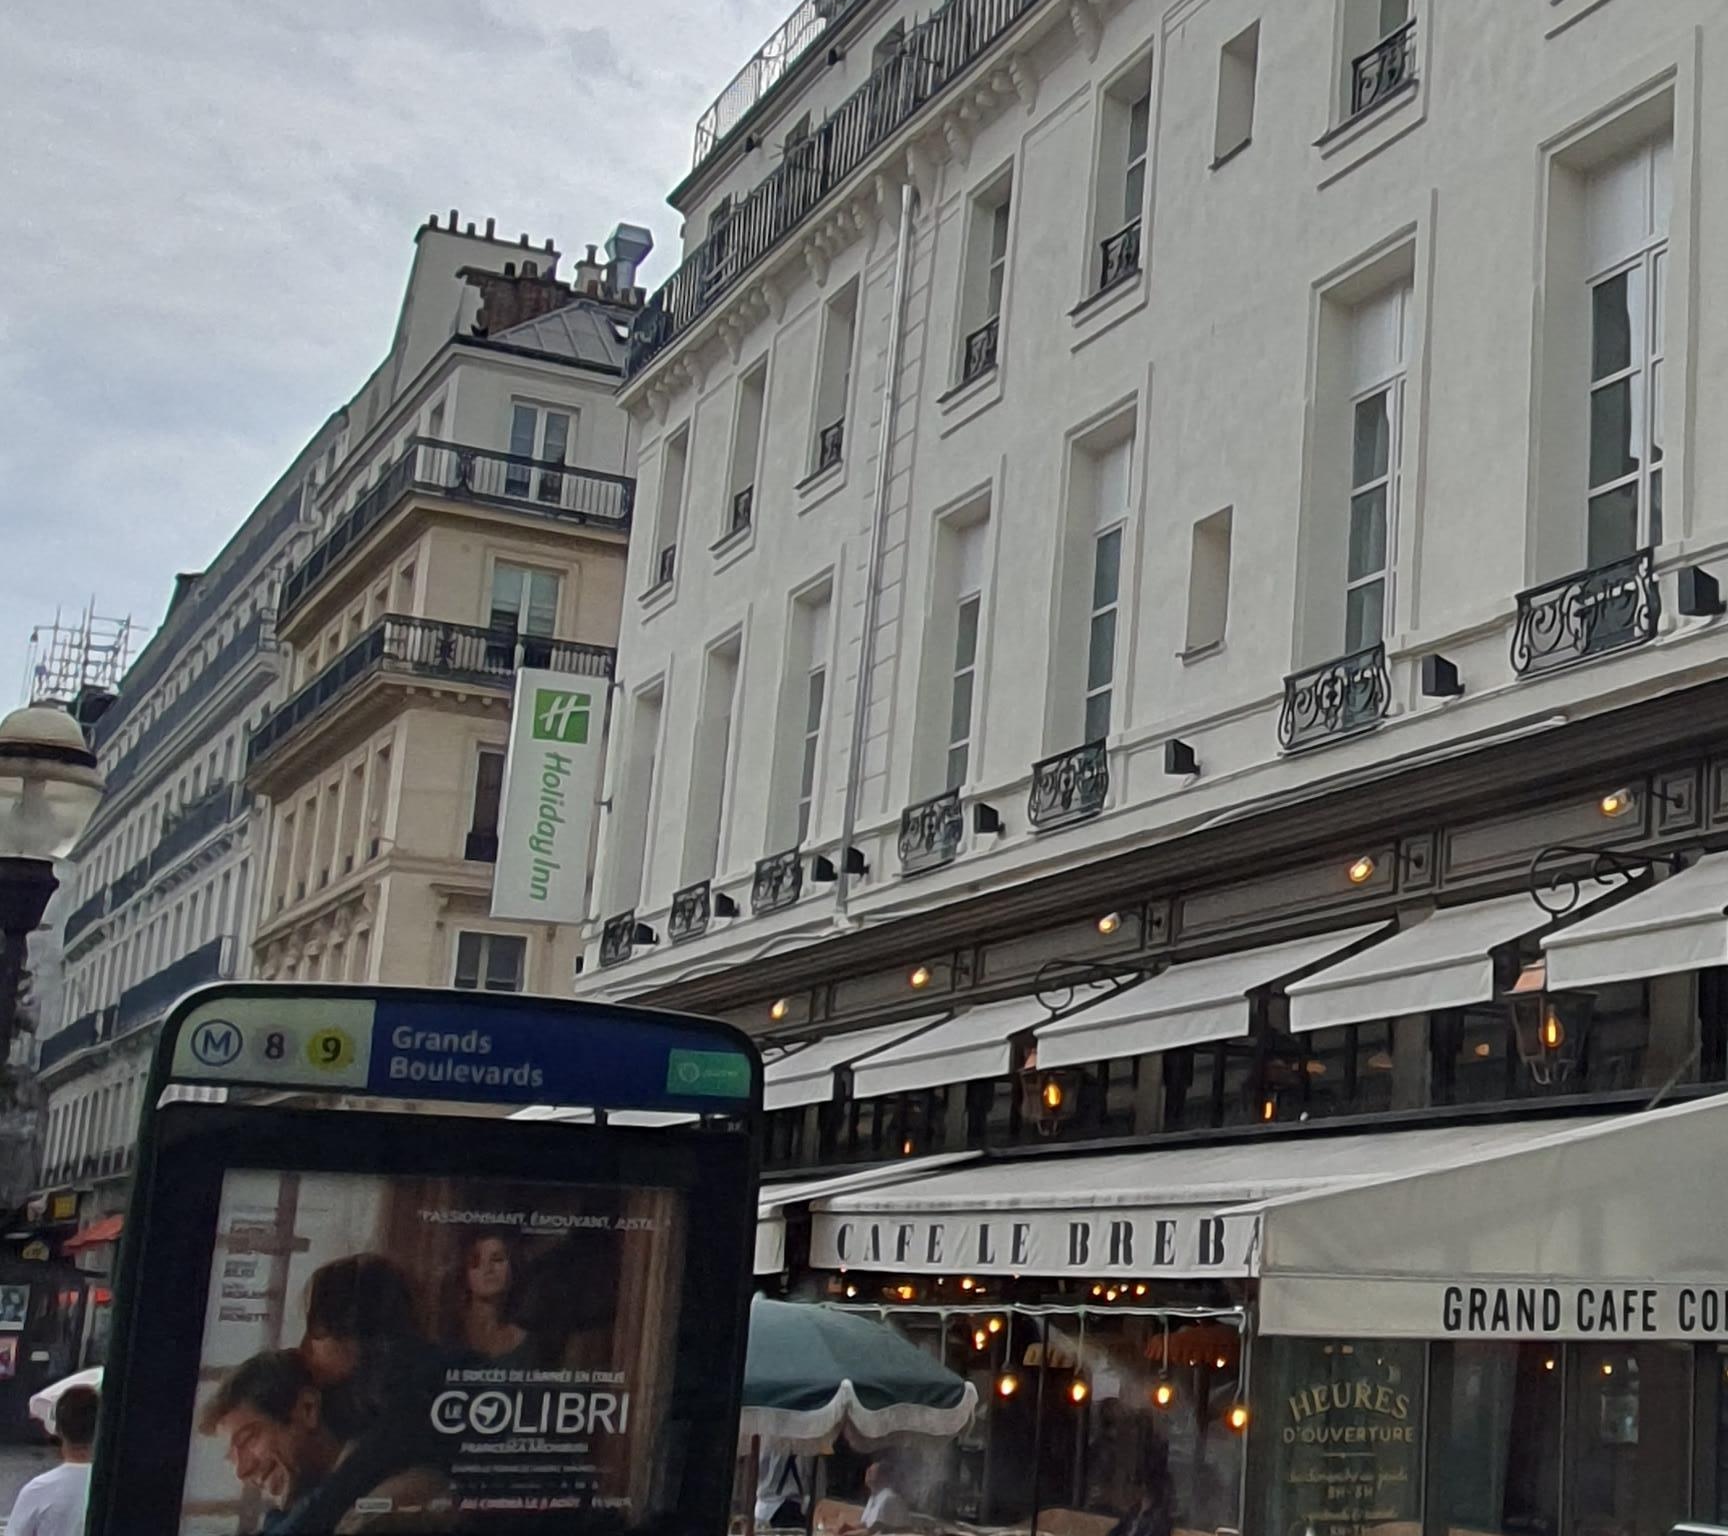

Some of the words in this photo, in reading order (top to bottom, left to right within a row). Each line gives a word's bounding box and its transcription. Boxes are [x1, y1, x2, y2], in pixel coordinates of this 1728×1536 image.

[528, 750, 573, 855] Holiday
[529, 857, 561, 902] Inn
[264, 1031, 285, 1060] 8
[321, 1036, 342, 1062] 9
[391, 1025, 492, 1055] Grands
[388, 1056, 544, 1088] Boulevards
[836, 1220, 945, 1264] CAFE
[976, 1221, 1031, 1265] LE
[1442, 1286, 1561, 1332] GRAND
[1576, 1289, 1657, 1332] CAFE
[430, 1390, 630, 1434] COLIBRI
[1288, 1382, 1410, 1423] HEURES
[1282, 1426, 1415, 1444] D'OUVERTURE
